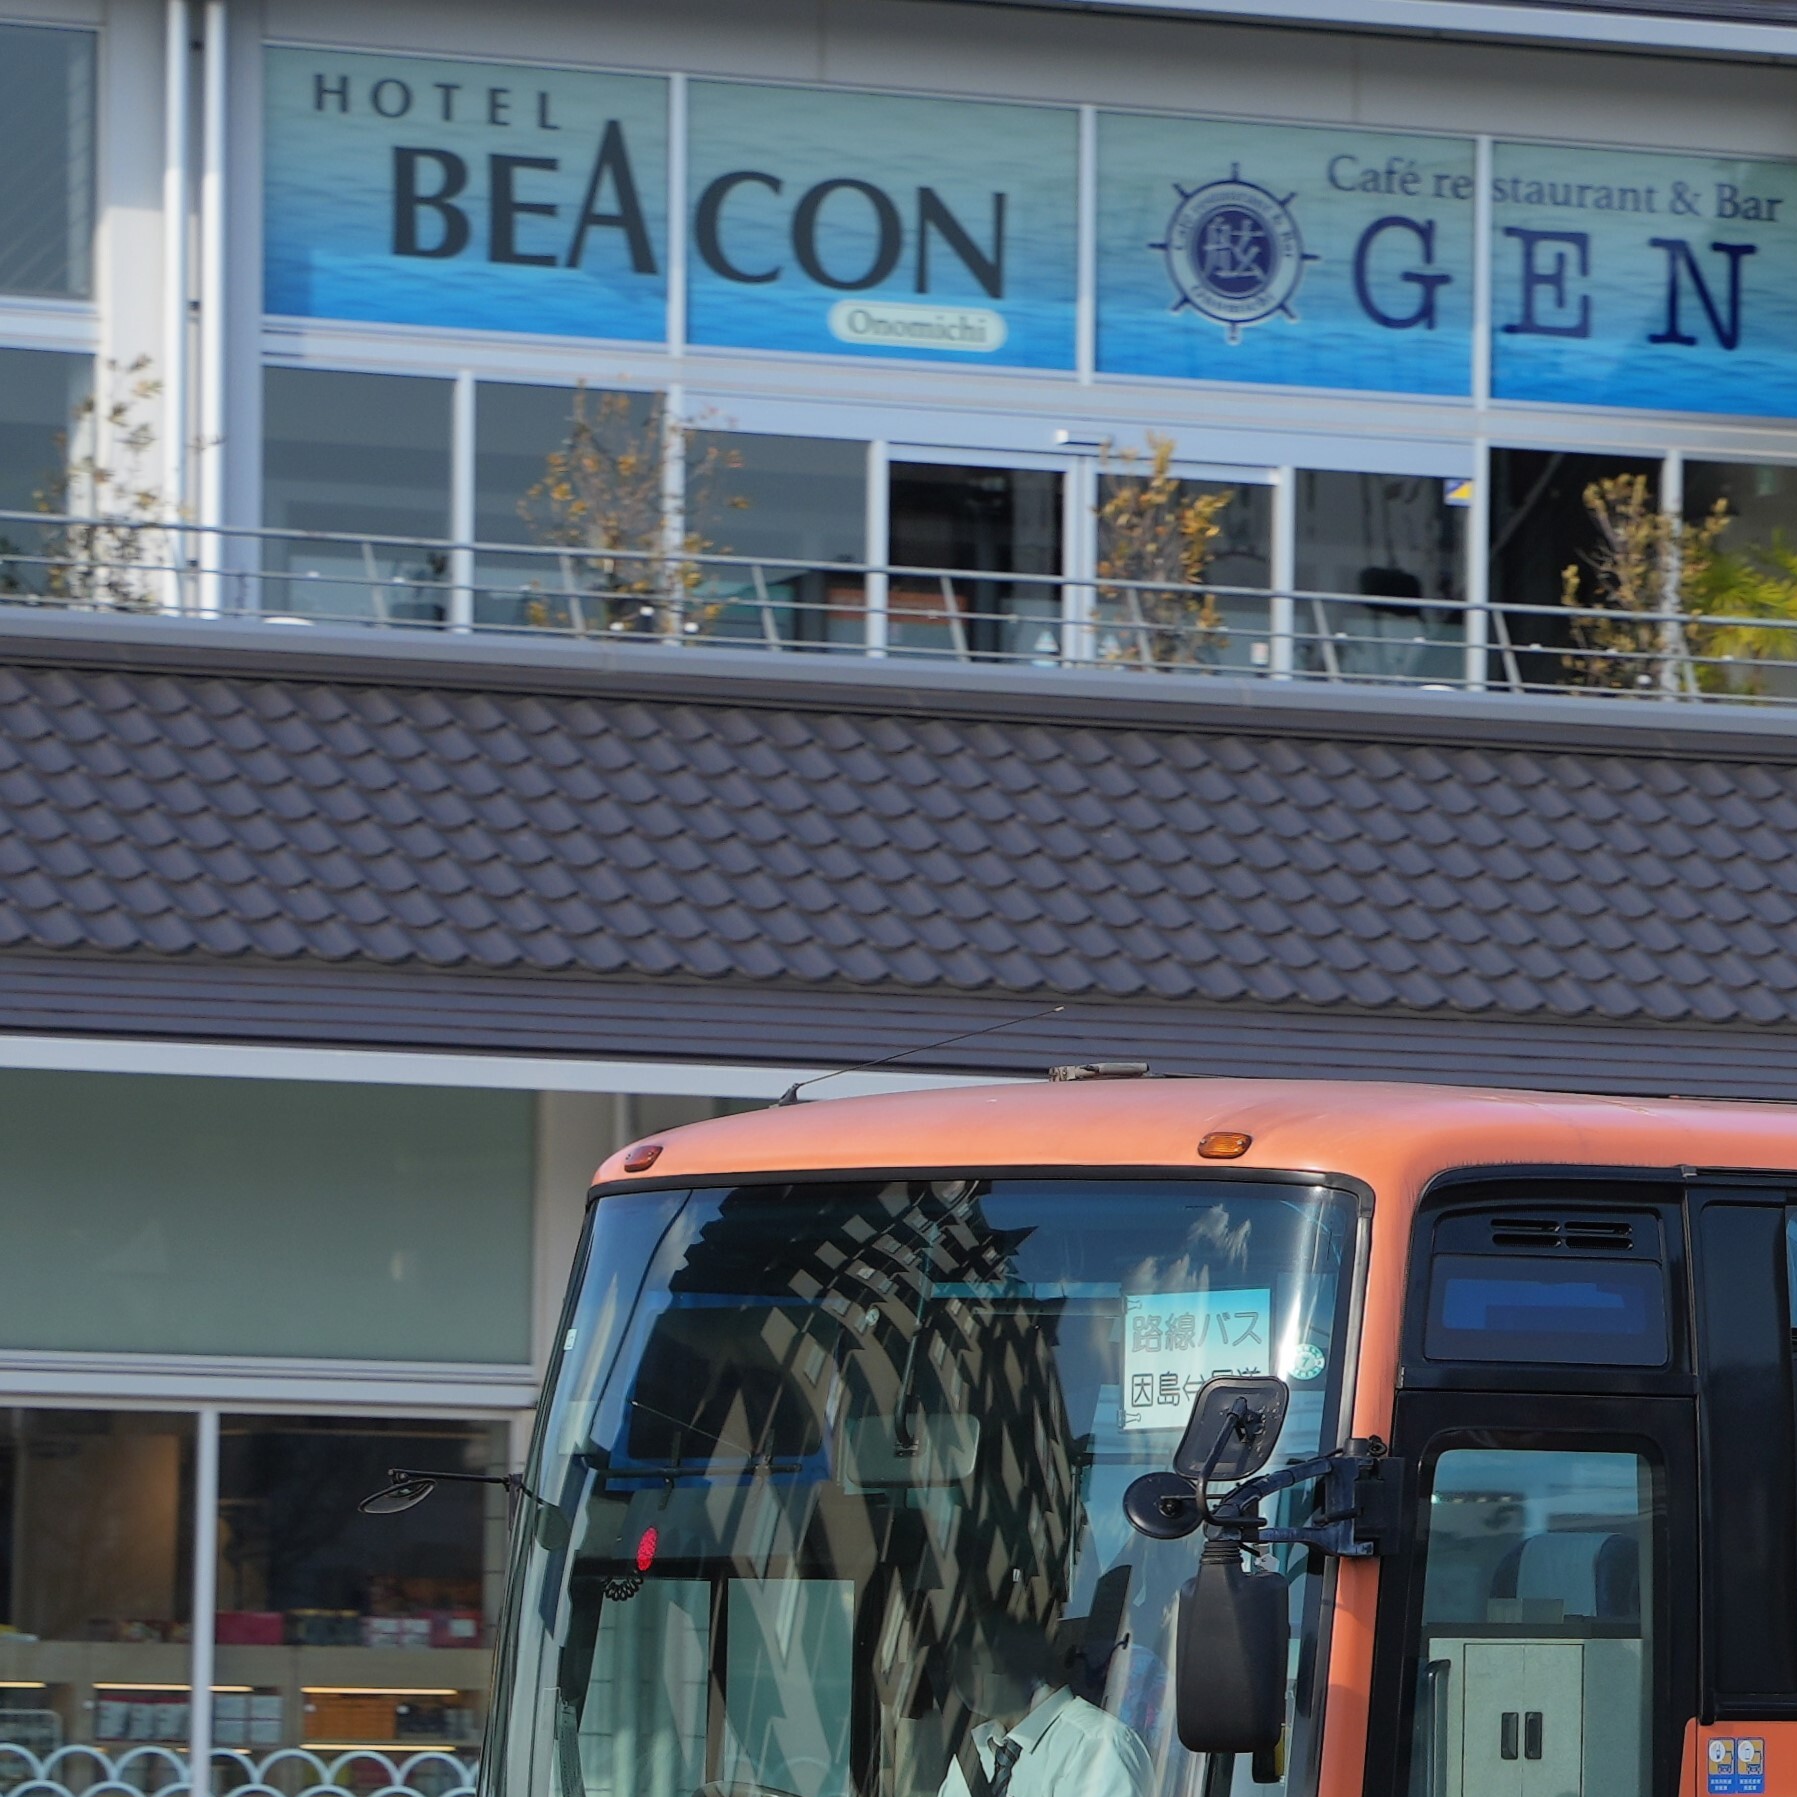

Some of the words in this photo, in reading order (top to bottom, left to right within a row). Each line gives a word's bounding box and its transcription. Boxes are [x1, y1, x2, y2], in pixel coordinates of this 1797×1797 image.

[313, 73, 561, 131] HOTEL
[391, 119, 1008, 299] BEACON
[1326, 153, 1421, 197] Café
[1432, 171, 1658, 214] restaurant
[1668, 180, 1702, 216] &
[1713, 182, 1785, 223] Bar
[1351, 215, 1758, 352] GEN
[846, 308, 988, 344] Onomichi
[1131, 1311, 1263, 1353] 路線バス
[1131, 1370, 1181, 1407] 因島
